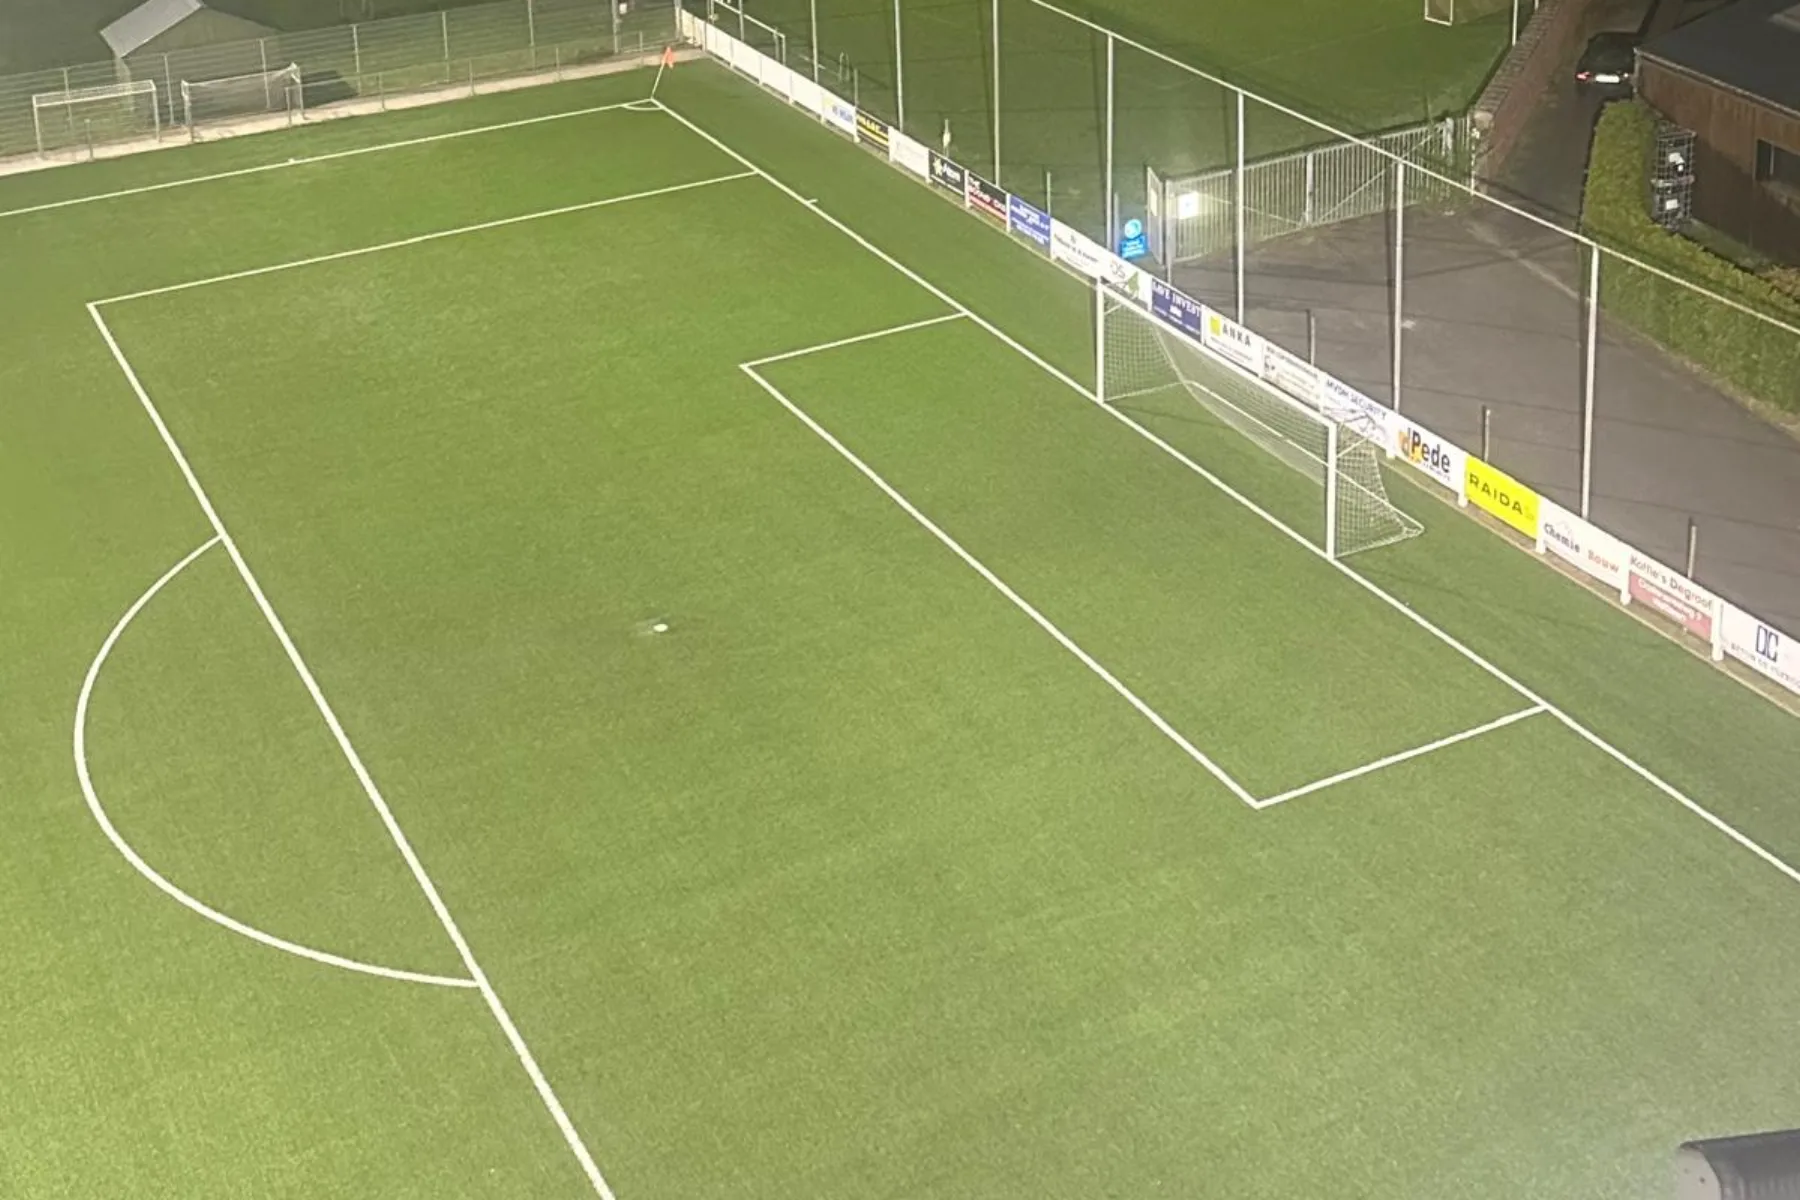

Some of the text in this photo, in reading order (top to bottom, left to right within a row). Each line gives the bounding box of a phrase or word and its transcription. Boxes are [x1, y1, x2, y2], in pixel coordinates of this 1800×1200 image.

[1172, 292, 1201, 318] INVEST
[1469, 472, 1523, 516] RAIDA
[1544, 522, 1620, 574] Chemie Bouw
